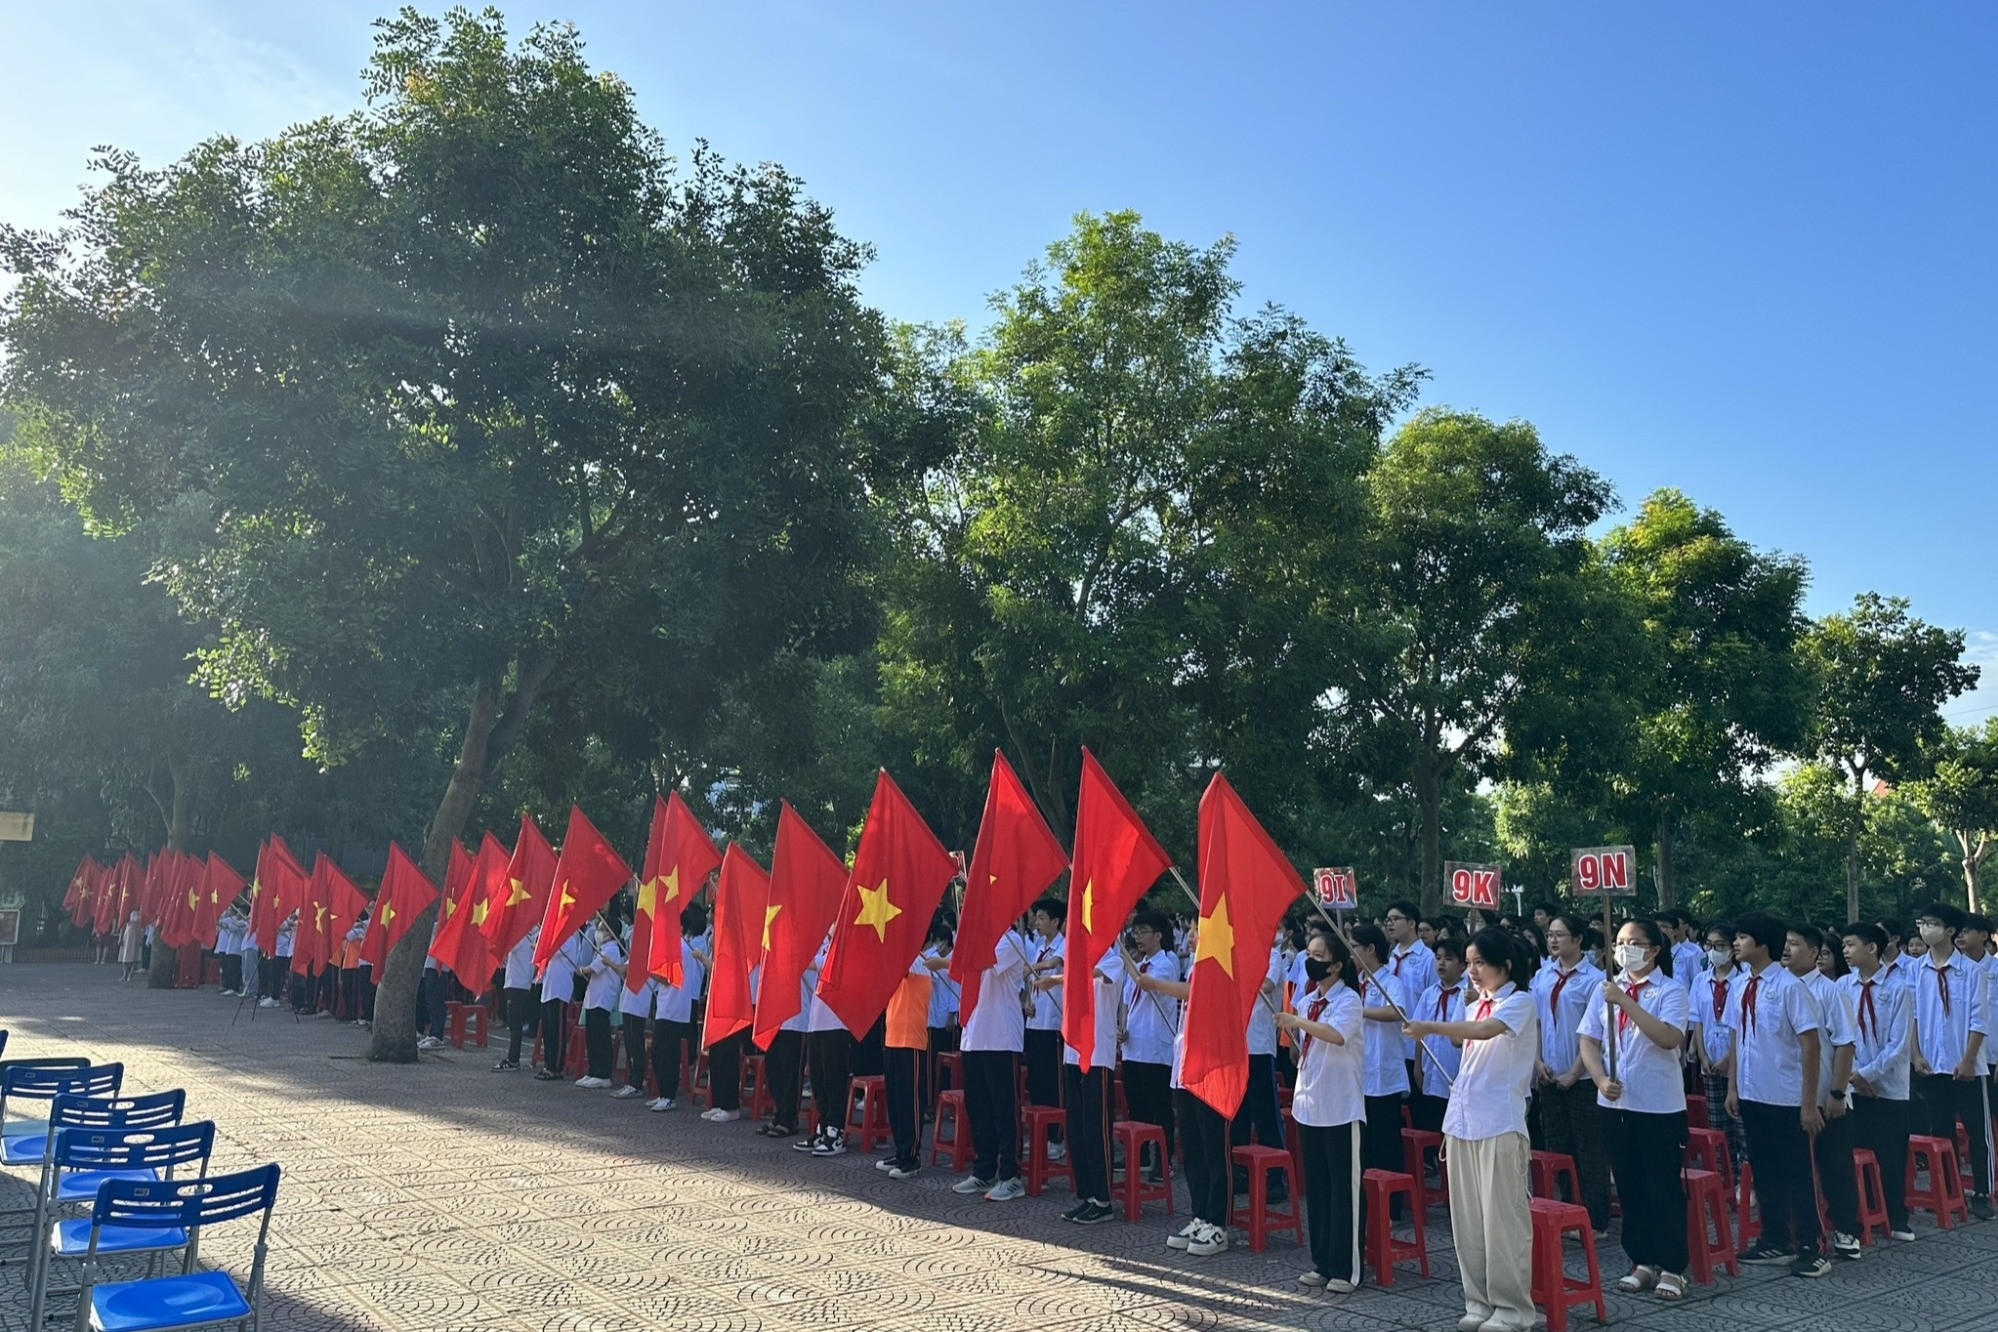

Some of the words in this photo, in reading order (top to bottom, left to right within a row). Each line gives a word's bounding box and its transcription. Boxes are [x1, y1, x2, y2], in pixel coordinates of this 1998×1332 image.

[1320, 874, 1348, 904] 9I
[1452, 869, 1495, 905] 9K
[1578, 852, 1628, 890] 9N
